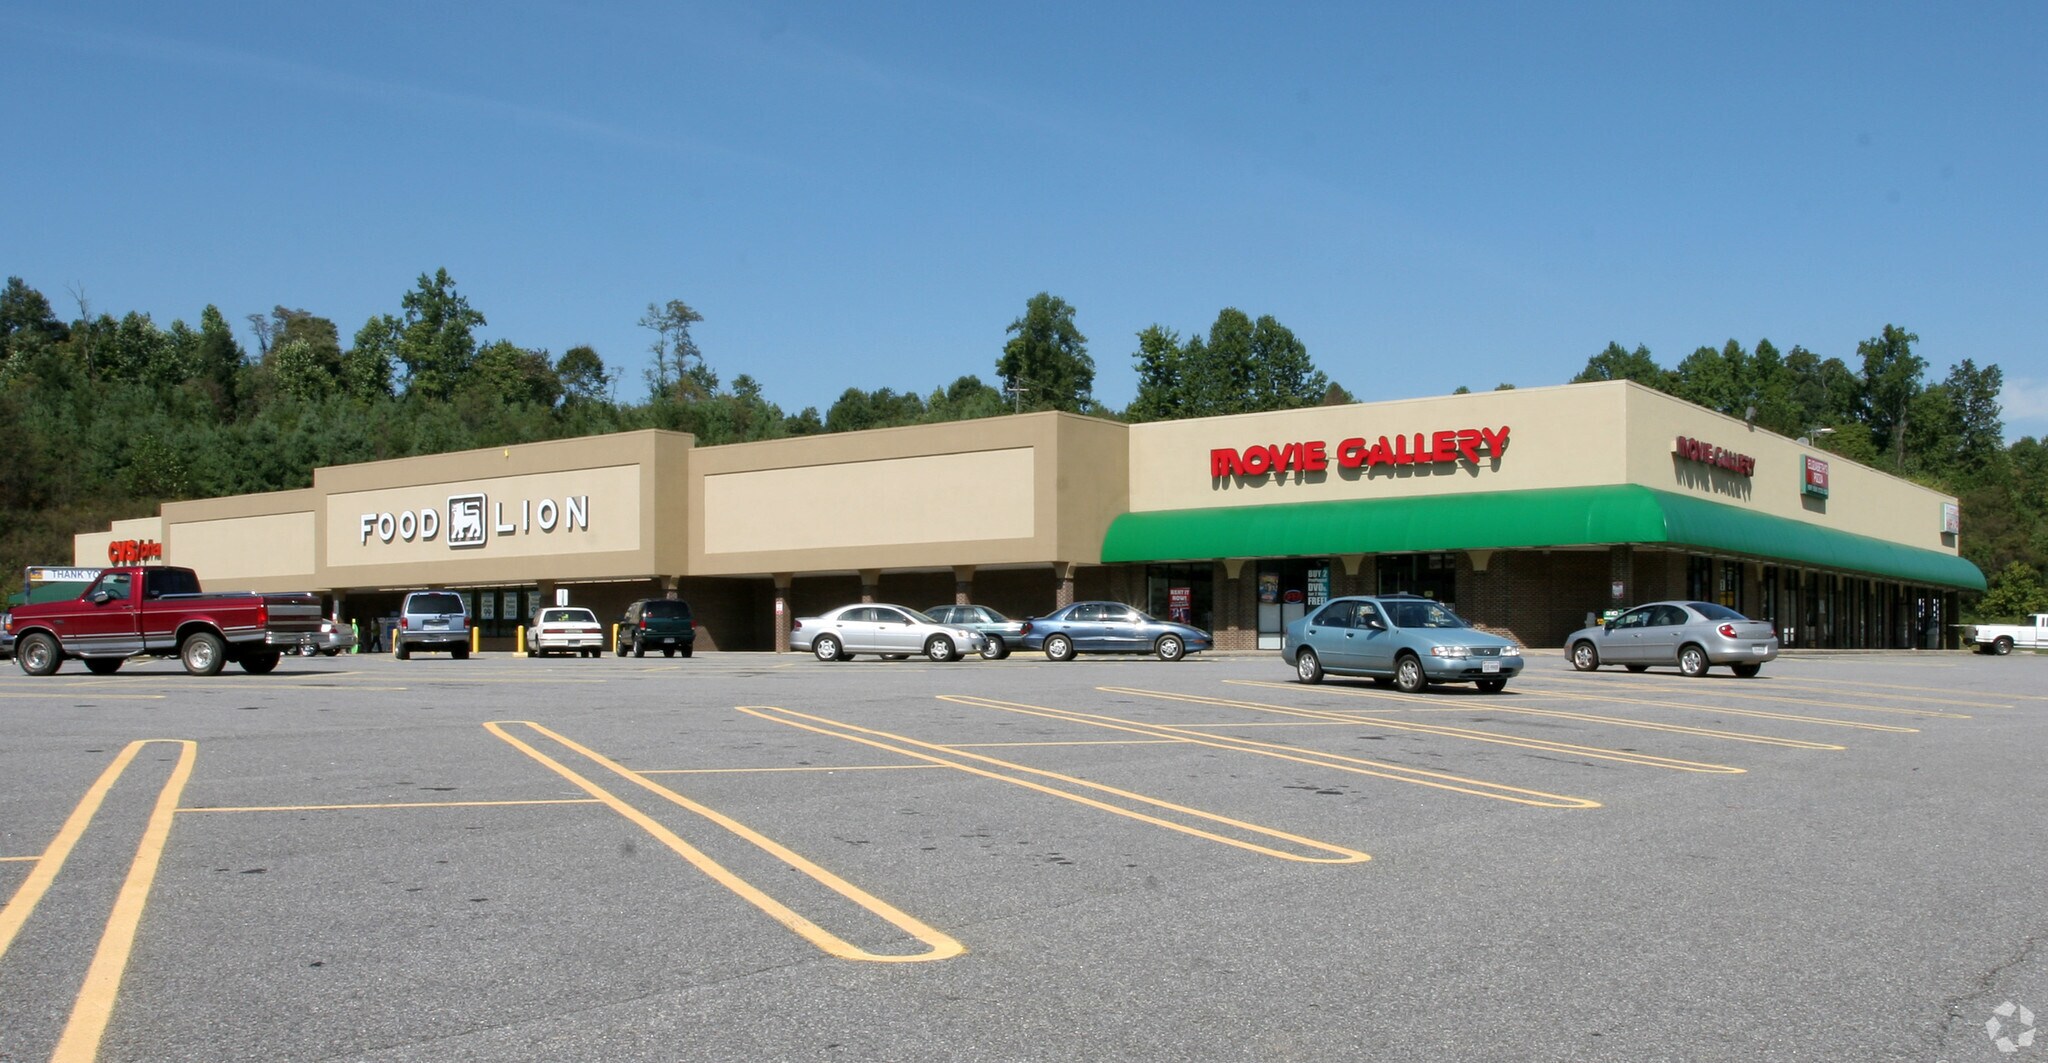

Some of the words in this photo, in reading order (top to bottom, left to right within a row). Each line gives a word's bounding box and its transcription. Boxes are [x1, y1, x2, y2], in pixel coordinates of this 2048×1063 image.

[1210, 440, 1327, 478] MOVIE
[1337, 425, 1511, 468] GALLERY
[1676, 435, 1714, 464] MOVIE
[1715, 446, 1756, 477] GALLERY
[360, 508, 439, 544] FOOD
[495, 495, 588, 533] LION
[53, 569, 84, 579] THANK
[1308, 597, 1327, 605] FREE!
